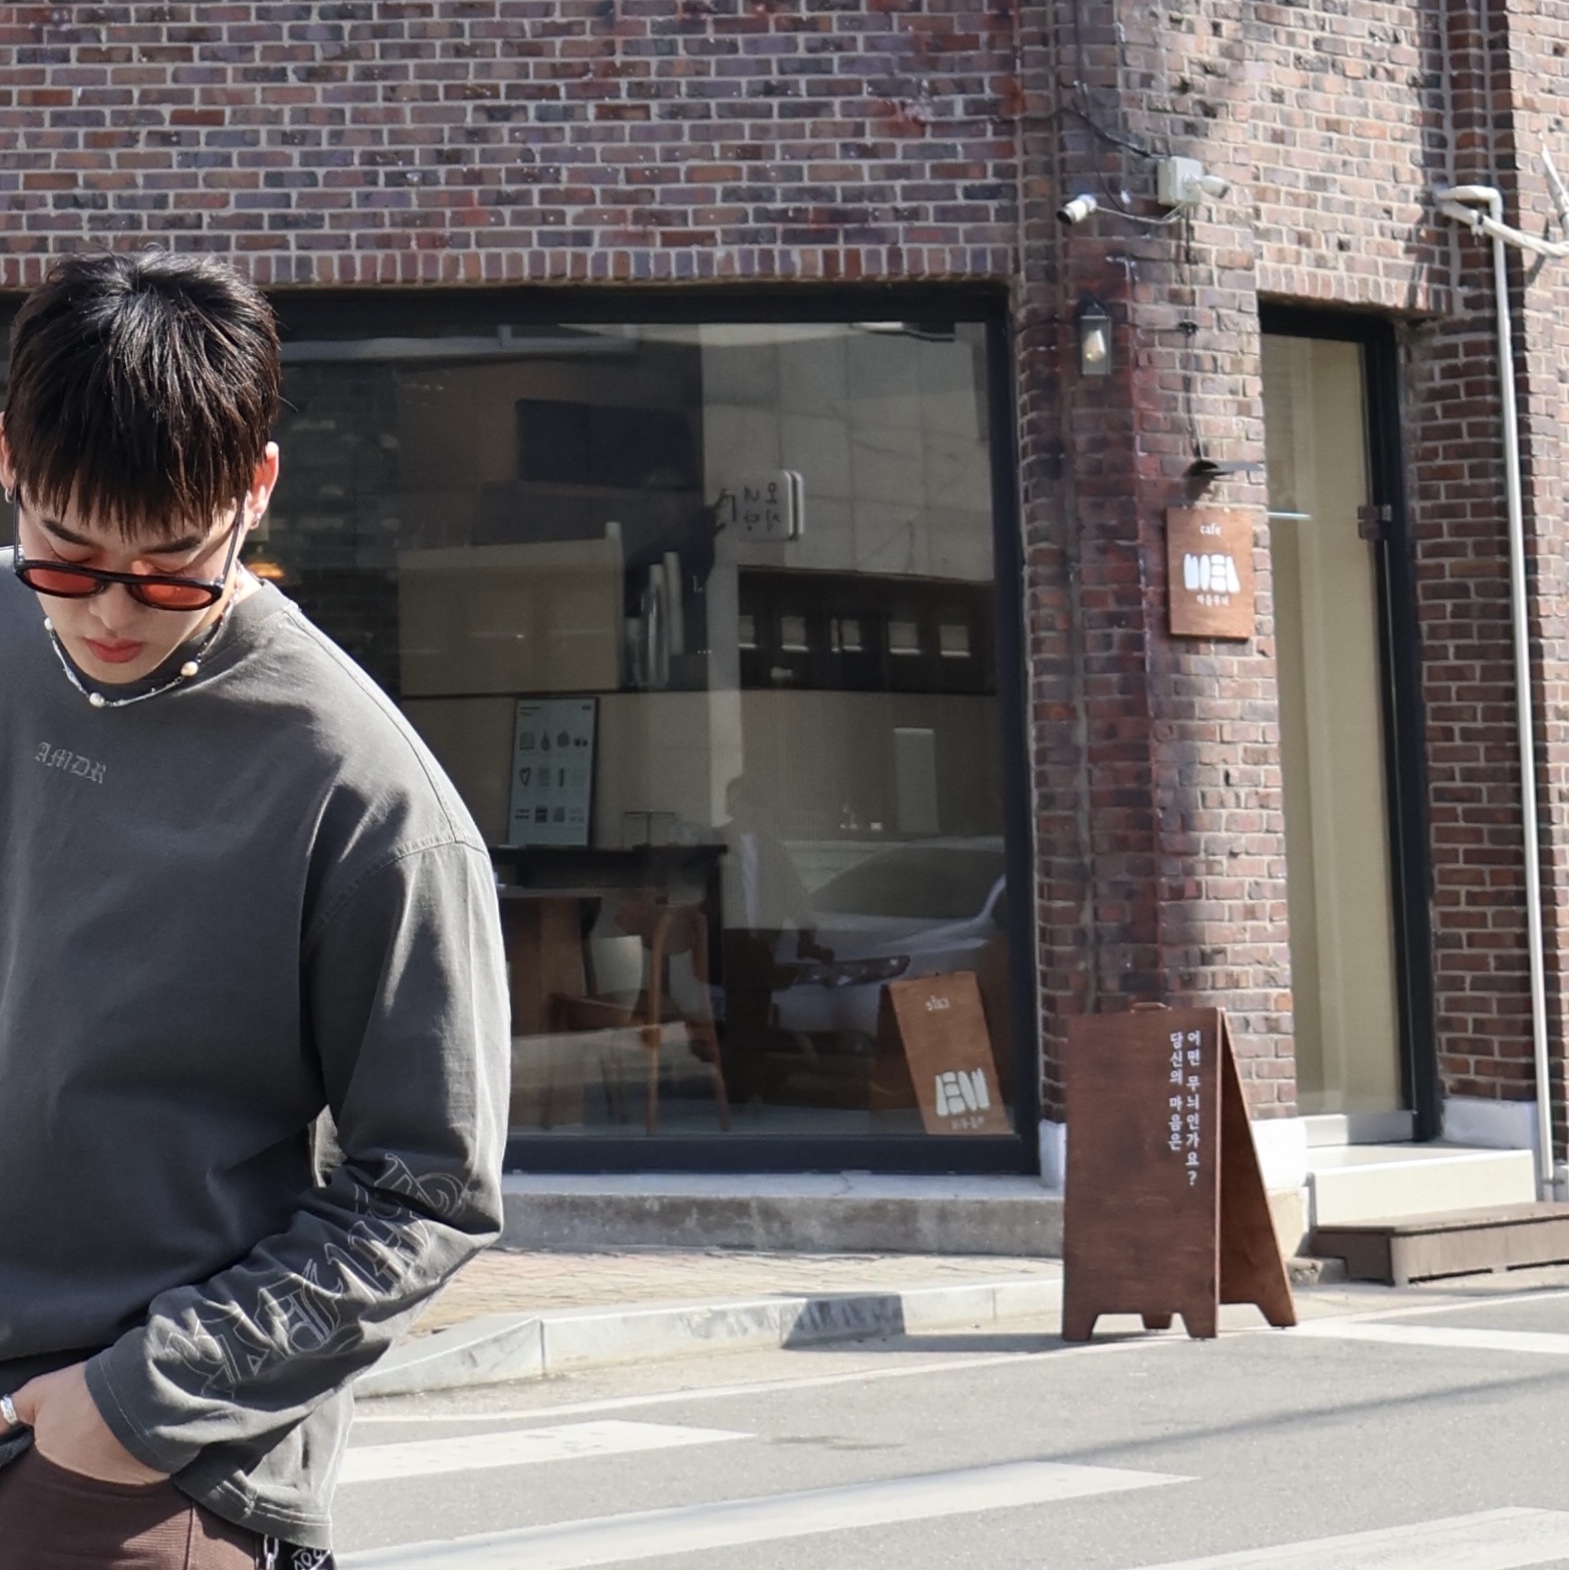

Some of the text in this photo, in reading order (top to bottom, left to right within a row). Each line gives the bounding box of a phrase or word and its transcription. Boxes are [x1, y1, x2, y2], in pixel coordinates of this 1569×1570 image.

[1199, 523, 1222, 536] cafe
[1168, 1031, 1184, 1151] 당신의 마음은
[1185, 1030, 1201, 1186] 어떤 무늬인가요?
